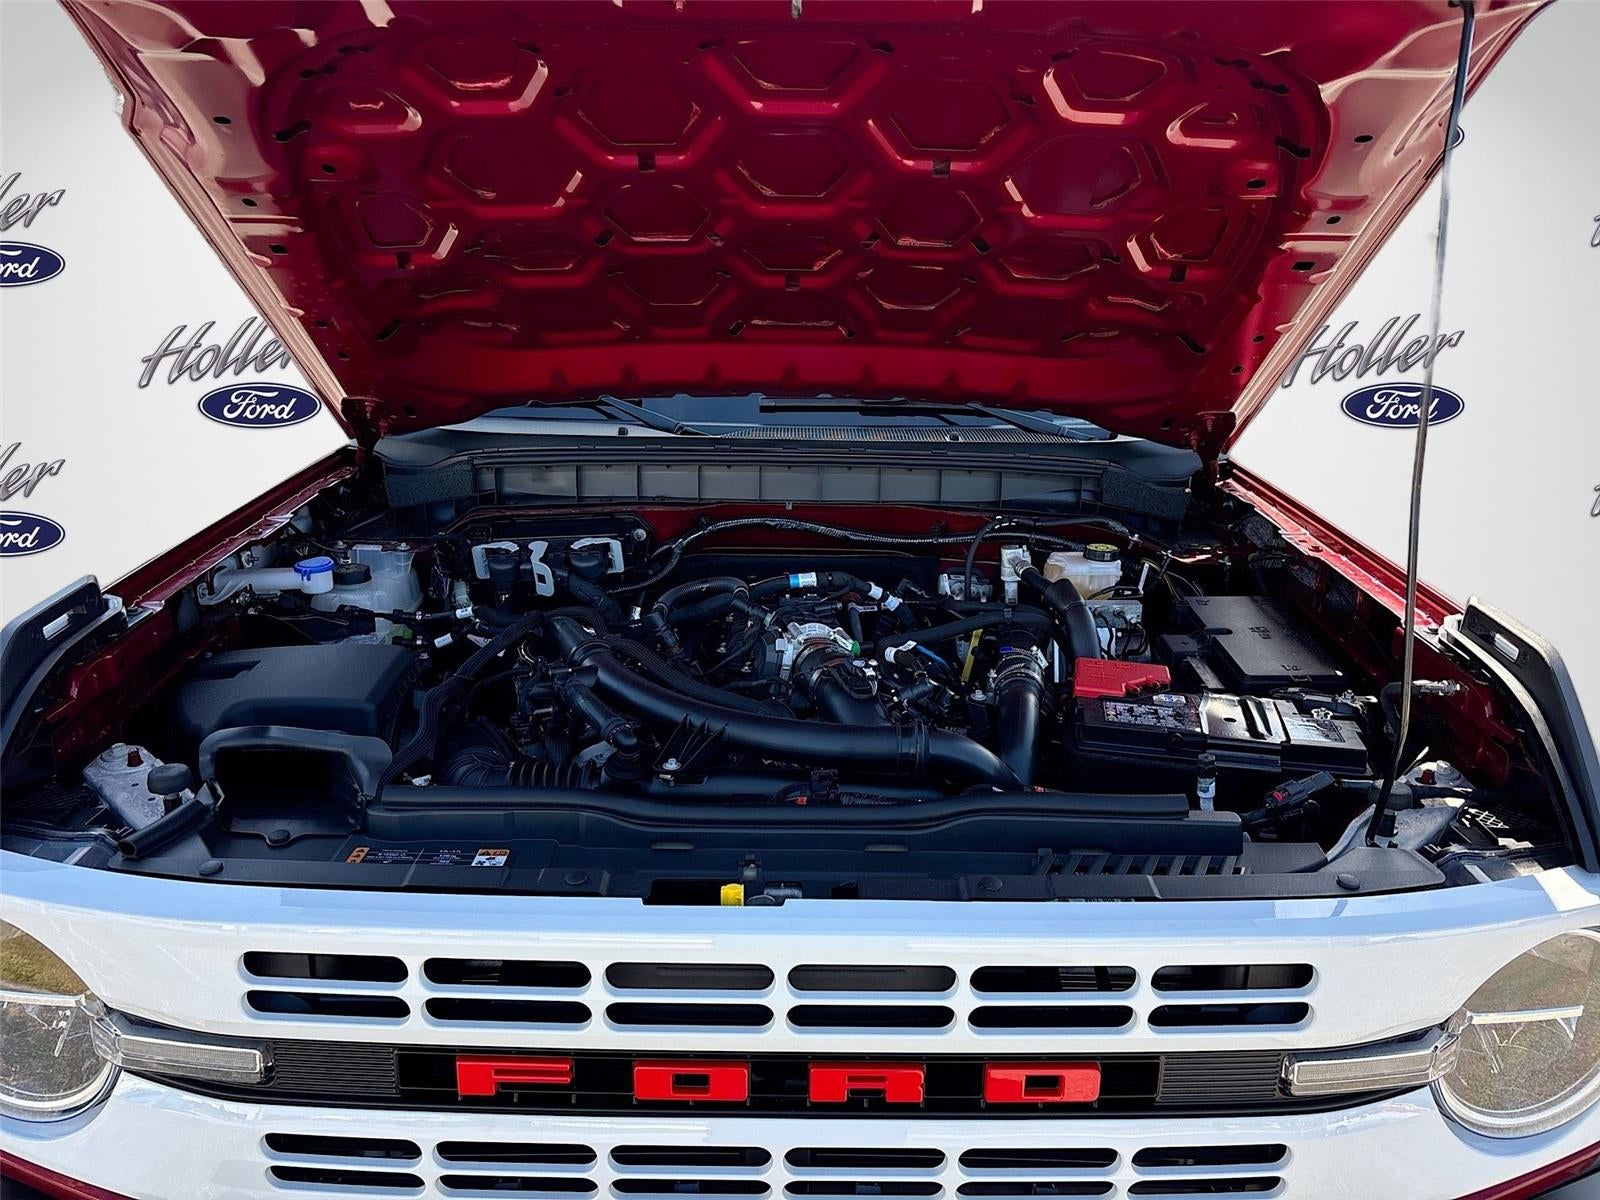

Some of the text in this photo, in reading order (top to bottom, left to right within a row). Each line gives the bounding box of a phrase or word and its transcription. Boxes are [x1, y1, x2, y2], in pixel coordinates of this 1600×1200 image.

[1281, 313, 1465, 389] Holler
[223, 389, 297, 420] Ford
[456, 1056, 1101, 1103] FORD
